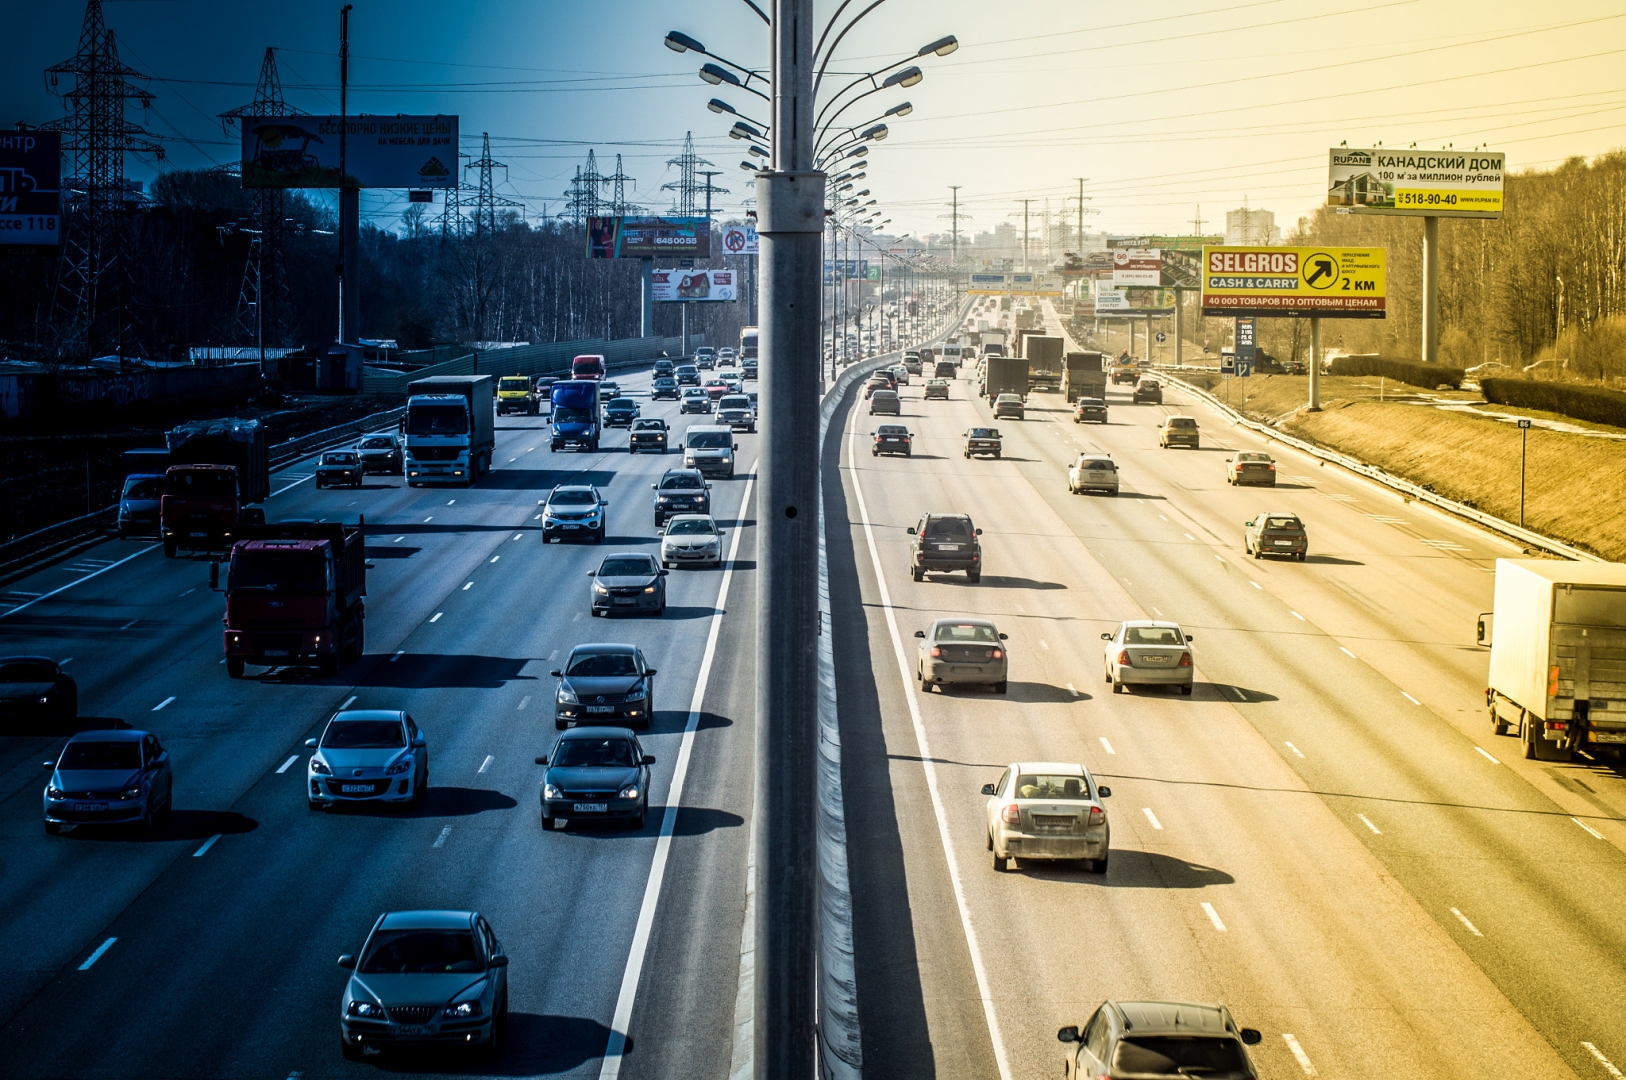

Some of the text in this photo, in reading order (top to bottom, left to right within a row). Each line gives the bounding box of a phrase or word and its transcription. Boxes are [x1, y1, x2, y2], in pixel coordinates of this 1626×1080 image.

[380, 123, 419, 135] НИЗКИЕ
[423, 123, 451, 136] ЦЕНЫ
[378, 137, 451, 146] НА МЕБЕЛЬ ДЛЯ ДАЧИ
[1333, 155, 1365, 164] RUPAN
[1378, 156, 1502, 171] КАНАДСКИЙ ДОМ
[1378, 171, 1394, 180] 100
[1419, 173, 1463, 181] миллион
[1465, 173, 1501, 183] рублей
[1405, 193, 1457, 204] 518-90-40
[27, 217, 56, 230] 118
[1210, 253, 1297, 273] SELGROS
[1210, 278, 1298, 289] CASH & CARRY
[1341, 277, 1350, 290] 2
[1209, 297, 1378, 307] 40 000 ТОВАРОВ ПО ОПТОВЫМ ЦЕНАМ
[1519, 420, 1529, 428] 86
